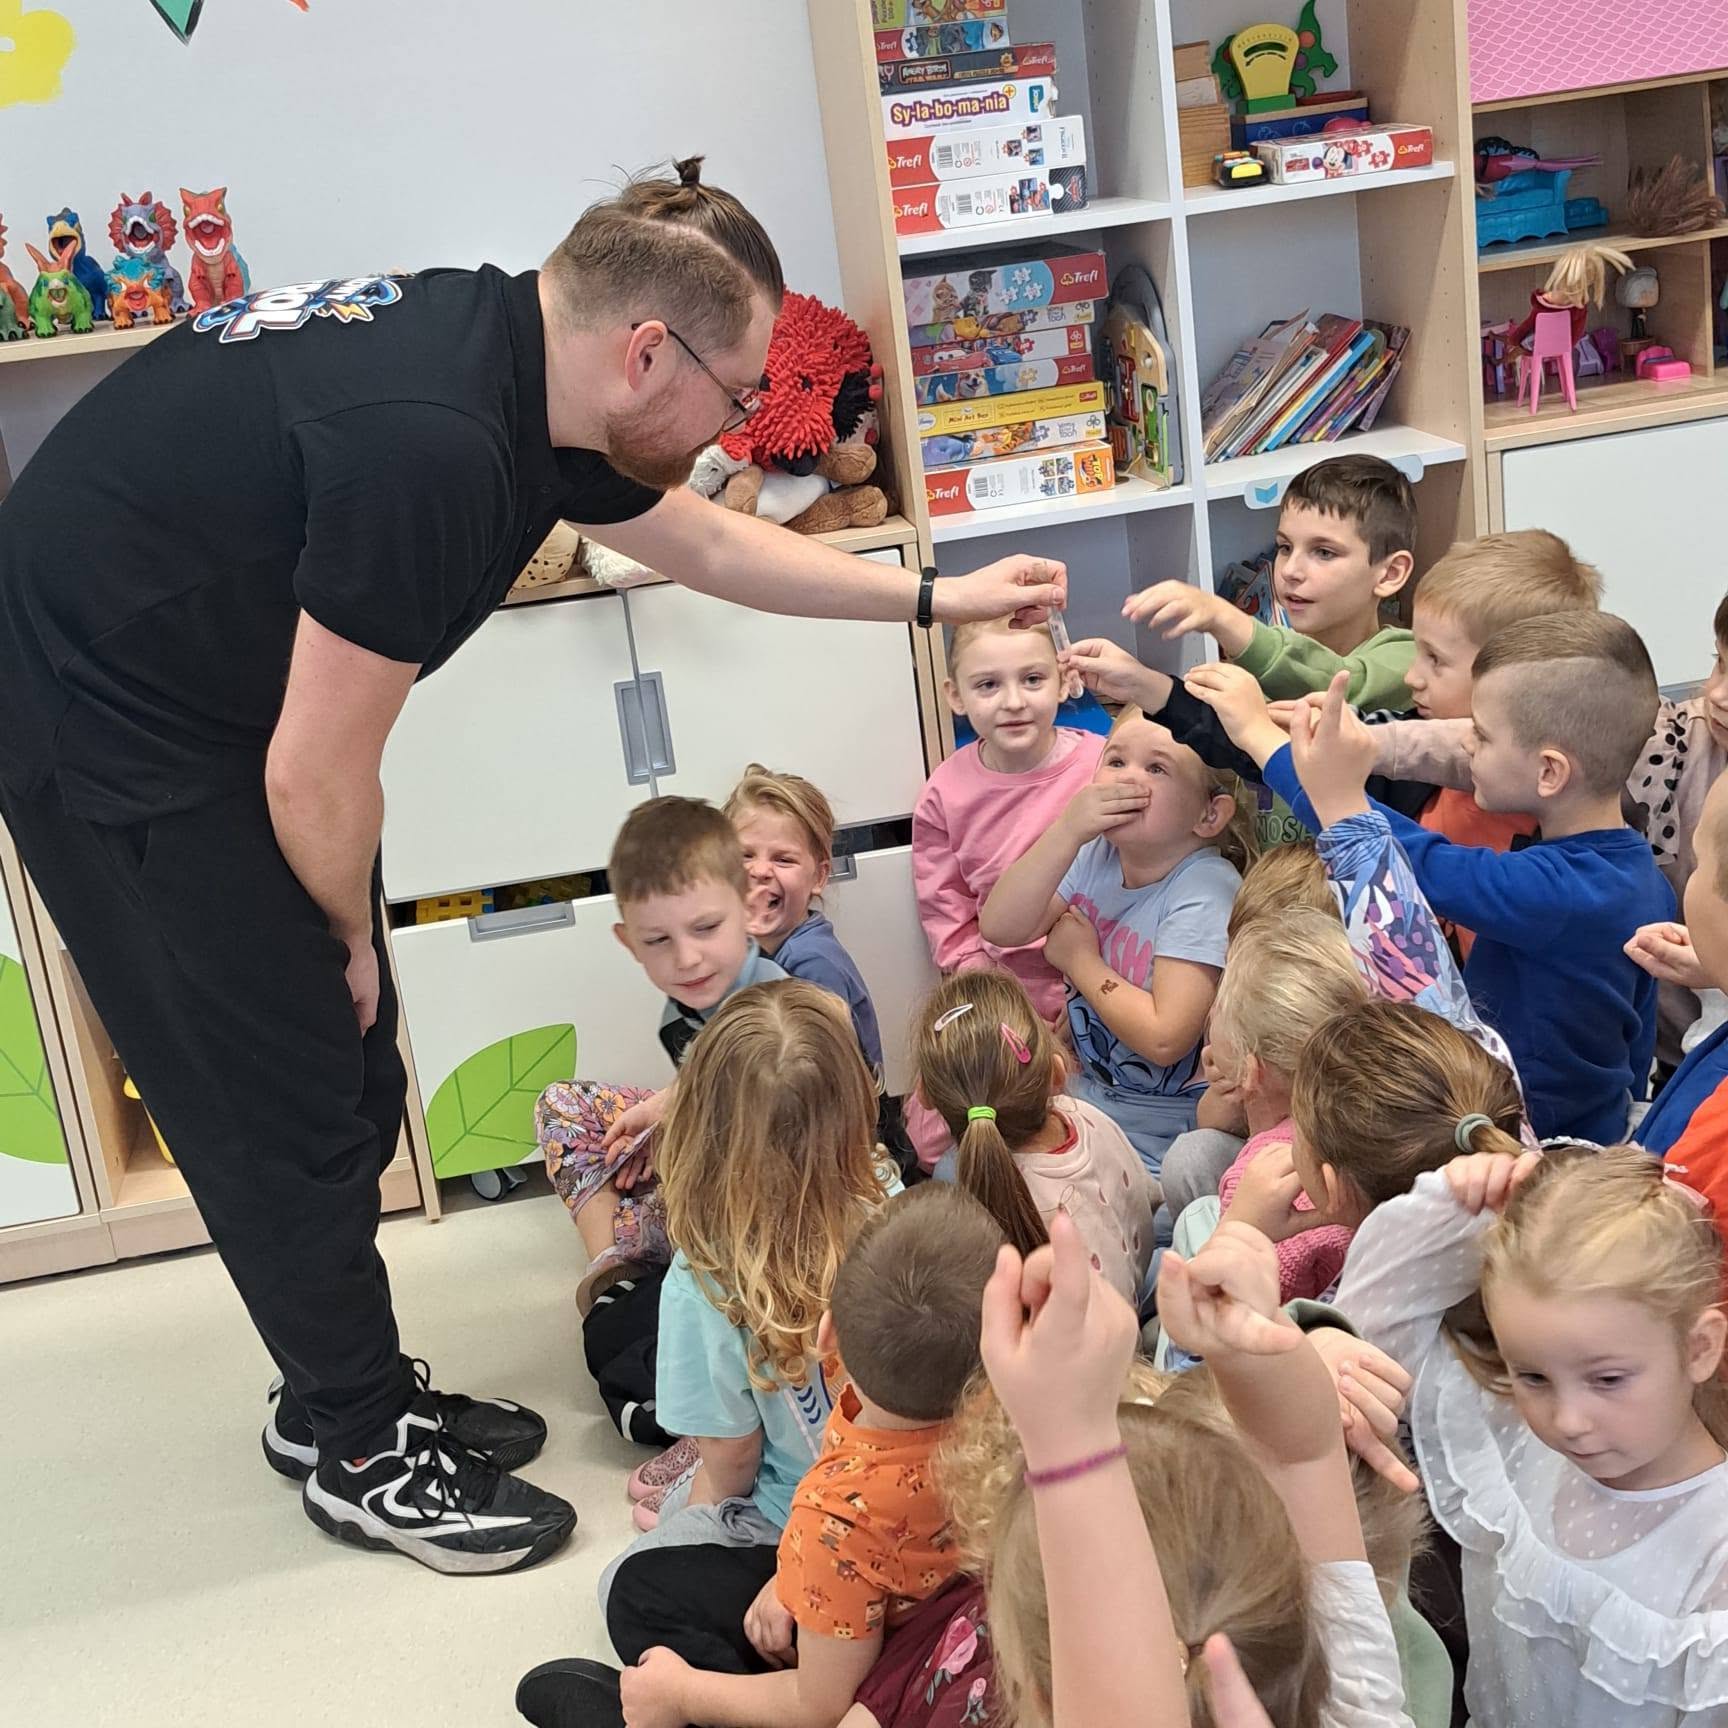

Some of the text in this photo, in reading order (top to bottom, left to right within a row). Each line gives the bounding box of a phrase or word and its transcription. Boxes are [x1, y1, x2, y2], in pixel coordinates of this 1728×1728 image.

[896, 154, 922, 168] Trefl
[902, 202, 928, 217] Trefl
[1074, 270, 1098, 283] Trefl
[935, 486, 959, 499] Trefl
